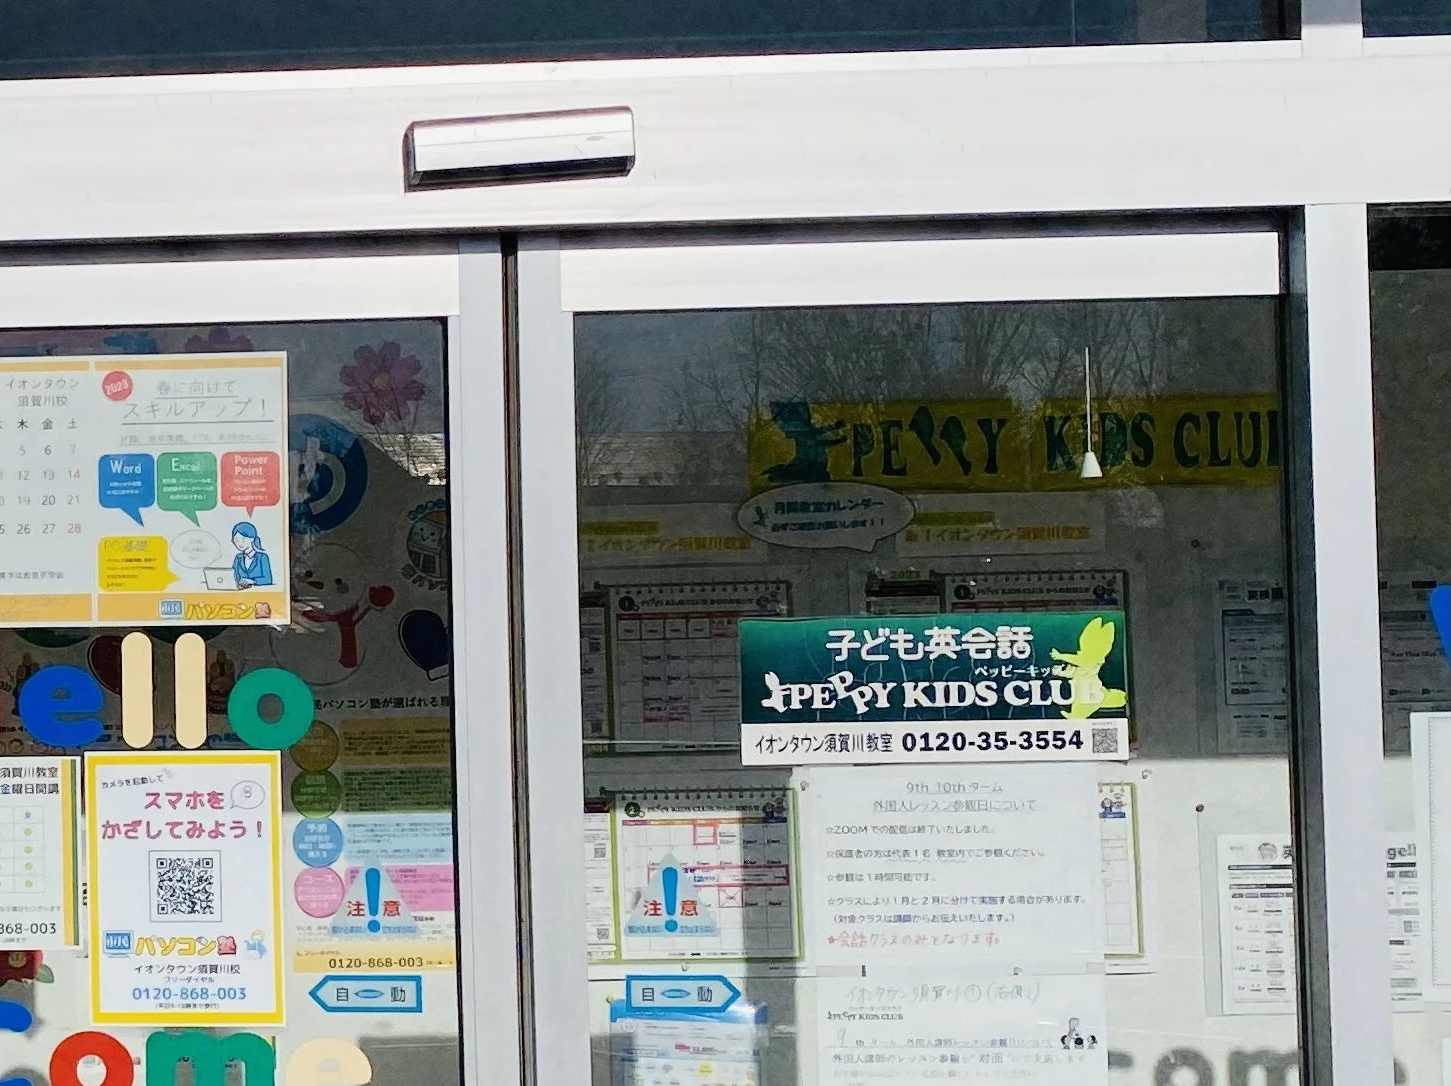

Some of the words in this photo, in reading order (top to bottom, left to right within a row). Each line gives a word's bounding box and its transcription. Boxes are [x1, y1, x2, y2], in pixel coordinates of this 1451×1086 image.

[105, 380, 129, 396] 2023
[157, 380, 238, 395] 春に向けて
[121, 398, 267, 419] スキルアップ!
[16, 418, 29, 430] 木
[1171, 410, 1280, 470] CLU
[109, 459, 142, 474] Word
[171, 457, 200, 472] Excel
[16, 524, 31, 534] 26
[826, 627, 1033, 662] 子ども英会話
[788, 670, 896, 714] PEPPY
[902, 681, 1001, 708] KIDS
[754, 732, 894, 755] イオンタウン須賀川教室
[902, 731, 1084, 753] 0120-35-3554
[101, 775, 164, 789] カメラを起動して
[144, 791, 225, 810] スマホを
[101, 820, 263, 840] かざしてみよう!
[347, 900, 366, 917] 注
[382, 900, 402, 917] 意
[643, 899, 664, 917] 注
[679, 899, 700, 917] 意
[133, 964, 241, 975] イオンタウン須賀川校
[328, 957, 424, 970] 0120-868-003
[132, 987, 247, 1000] 0120-868-003
[336, 988, 349, 1002] 自
[390, 987, 407, 1003] 動
[641, 987, 655, 1002] 自
[697, 986, 713, 1002] 動
